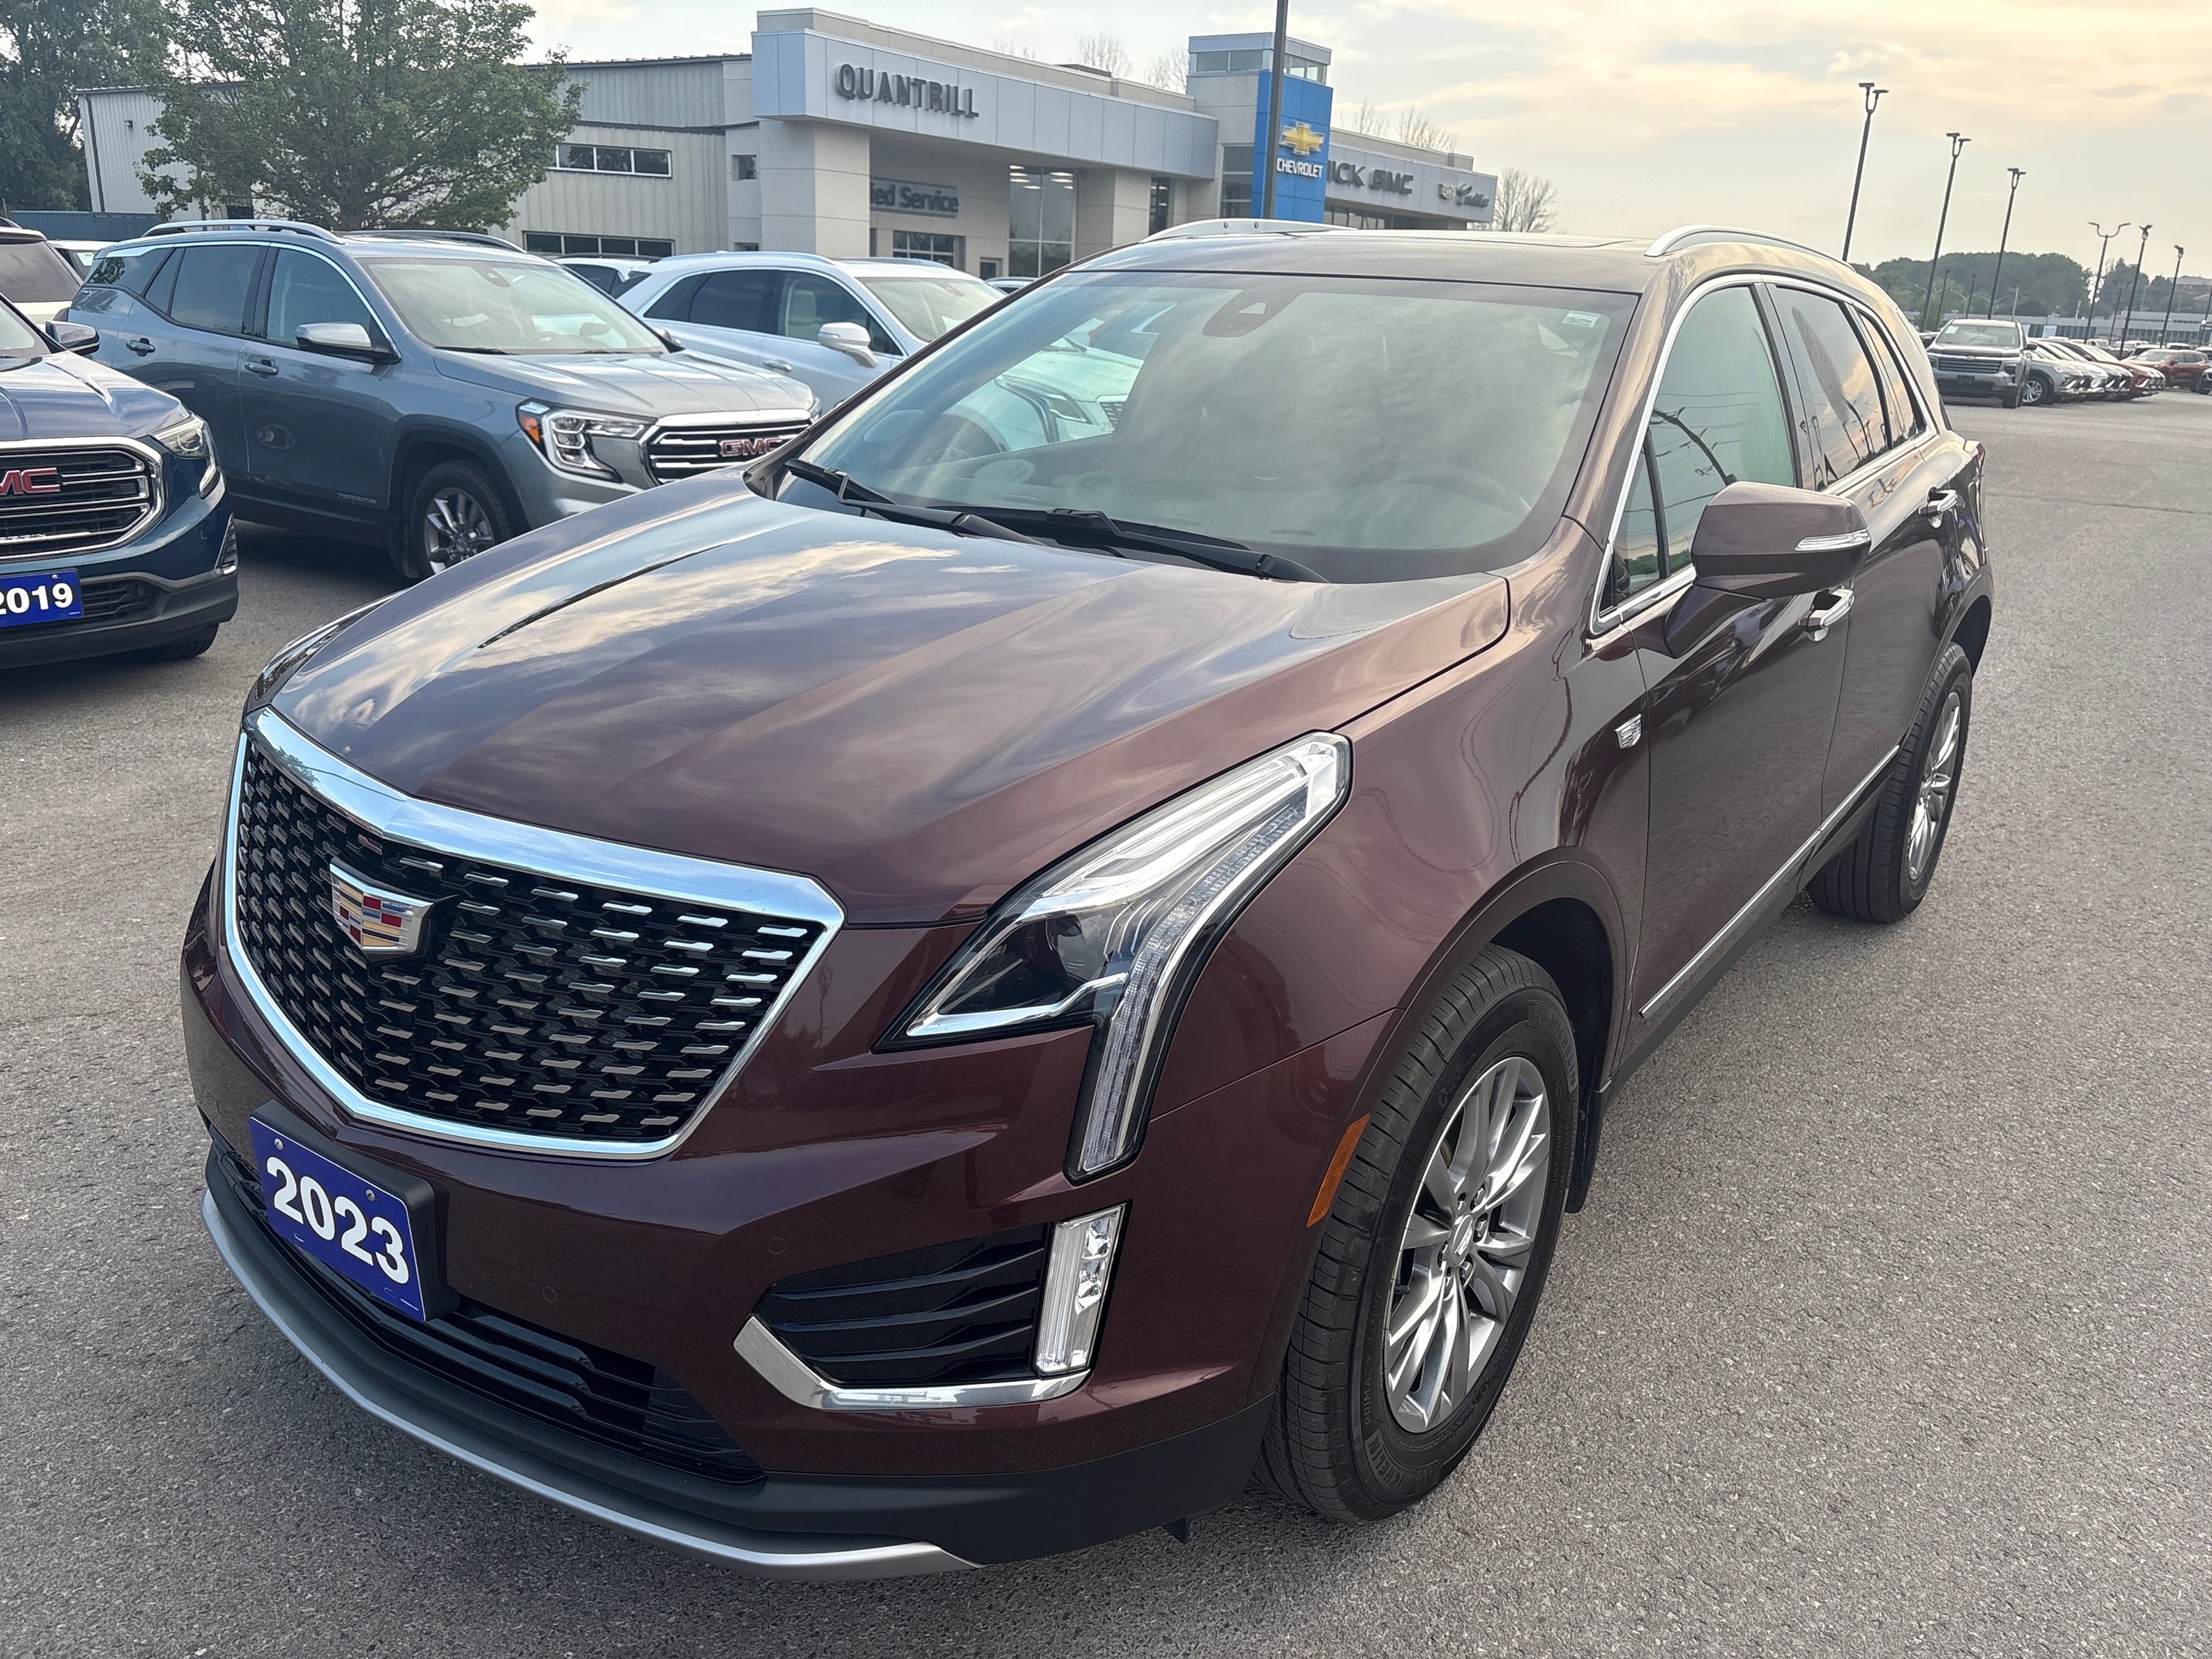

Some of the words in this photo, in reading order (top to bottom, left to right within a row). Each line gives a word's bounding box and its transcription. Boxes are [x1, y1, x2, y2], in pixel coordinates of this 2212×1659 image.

[835, 63, 979, 118] QUANTRILL
[1277, 157, 1323, 179] CHEVROLET
[1327, 160, 1366, 187] ICK
[1369, 169, 1414, 195] GMC
[899, 187, 959, 213] Service
[720, 437, 782, 458] GMC
[266, 1156, 409, 1284] 2023
[1363, 1354, 1373, 1426] PRIMACY
